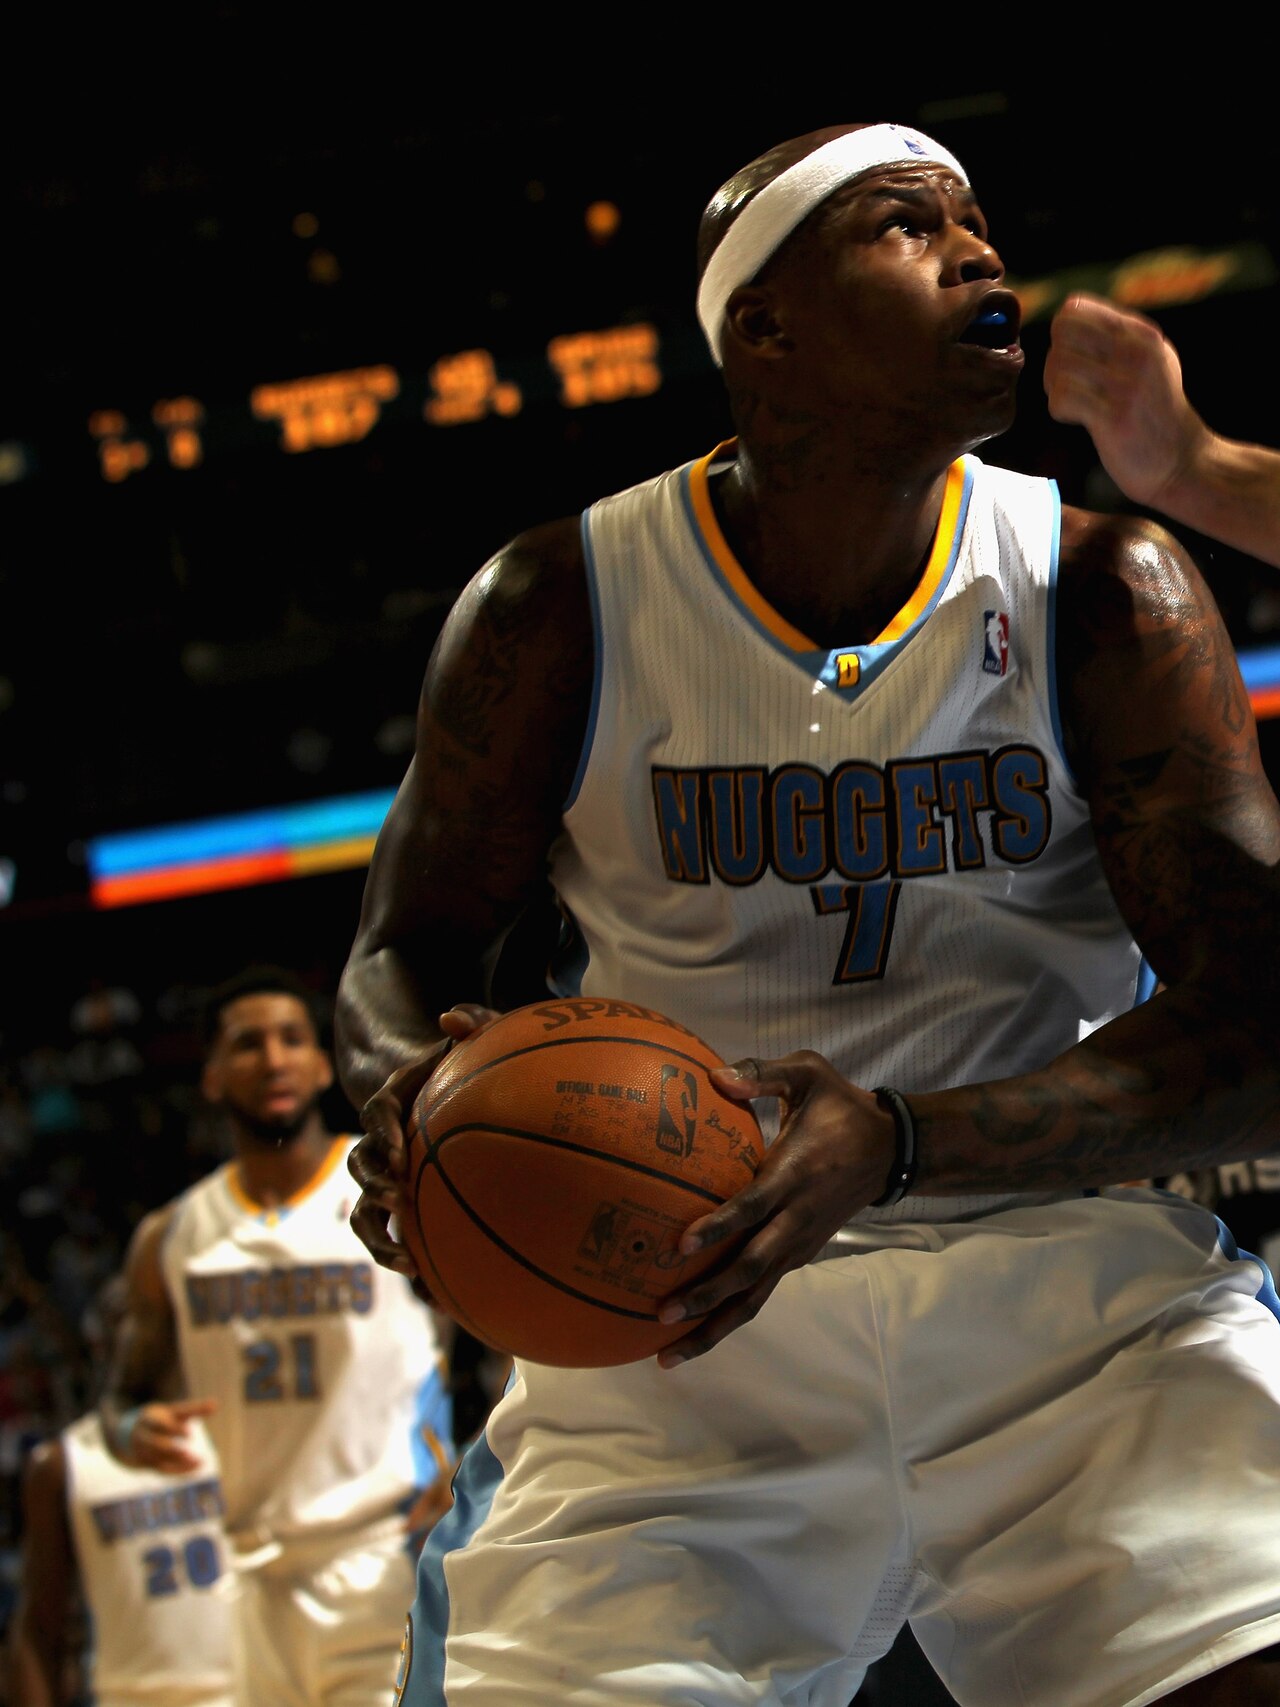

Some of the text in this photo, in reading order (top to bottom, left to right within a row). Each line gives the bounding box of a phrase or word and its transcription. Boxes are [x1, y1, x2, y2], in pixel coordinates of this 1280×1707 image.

[652, 745, 1051, 885] NUGGETS
[810, 882, 902, 985] 7
[244, 1335, 324, 1402] 21
[145, 1535, 221, 1595] 20
